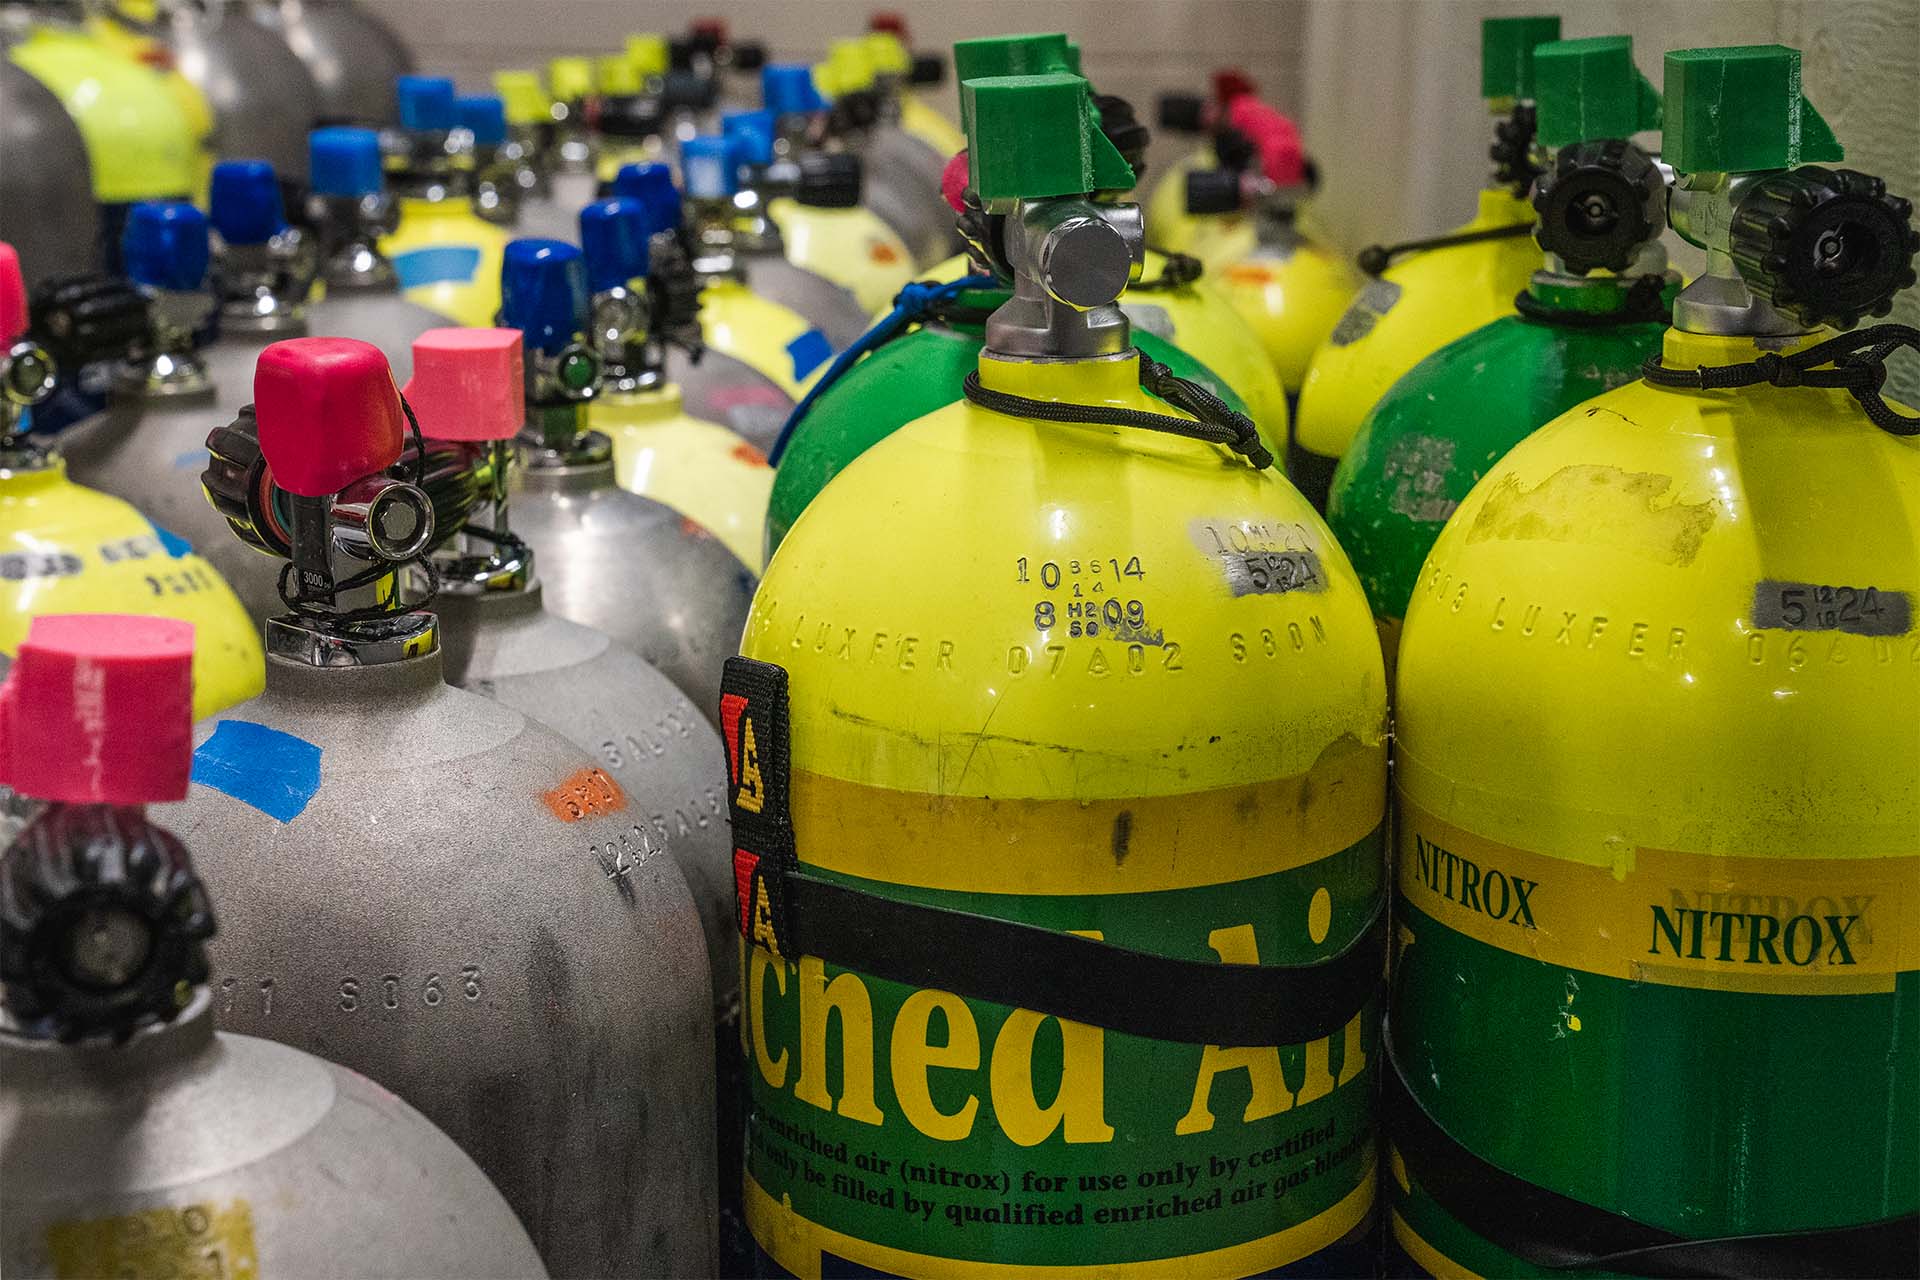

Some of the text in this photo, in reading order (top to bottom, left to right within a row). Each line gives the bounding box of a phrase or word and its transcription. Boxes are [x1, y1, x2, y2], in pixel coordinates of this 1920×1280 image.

[303, 570, 324, 588] 3000
[791, 614, 955, 672] LUXFER
[1490, 596, 1689, 661] LUXFER
[1414, 833, 1538, 931] NITROX
[1647, 904, 1859, 967] NITROX
[740, 929, 1115, 1148] ched
[854, 1151, 893, 1176] air
[900, 1158, 1010, 1196] (nitrox)
[1022, 1170, 1069, 1193] for
[1078, 1173, 1128, 1192] use
[1137, 1161, 1201, 1189] only
[1208, 1155, 1241, 1181] by
[1247, 1118, 1336, 1169] certified
[832, 1172, 895, 1210] filled
[903, 1190, 937, 1222] by
[944, 1202, 1084, 1228] qualified
[1092, 1187, 1223, 1226] enriched
[1229, 1180, 1266, 1205] air
